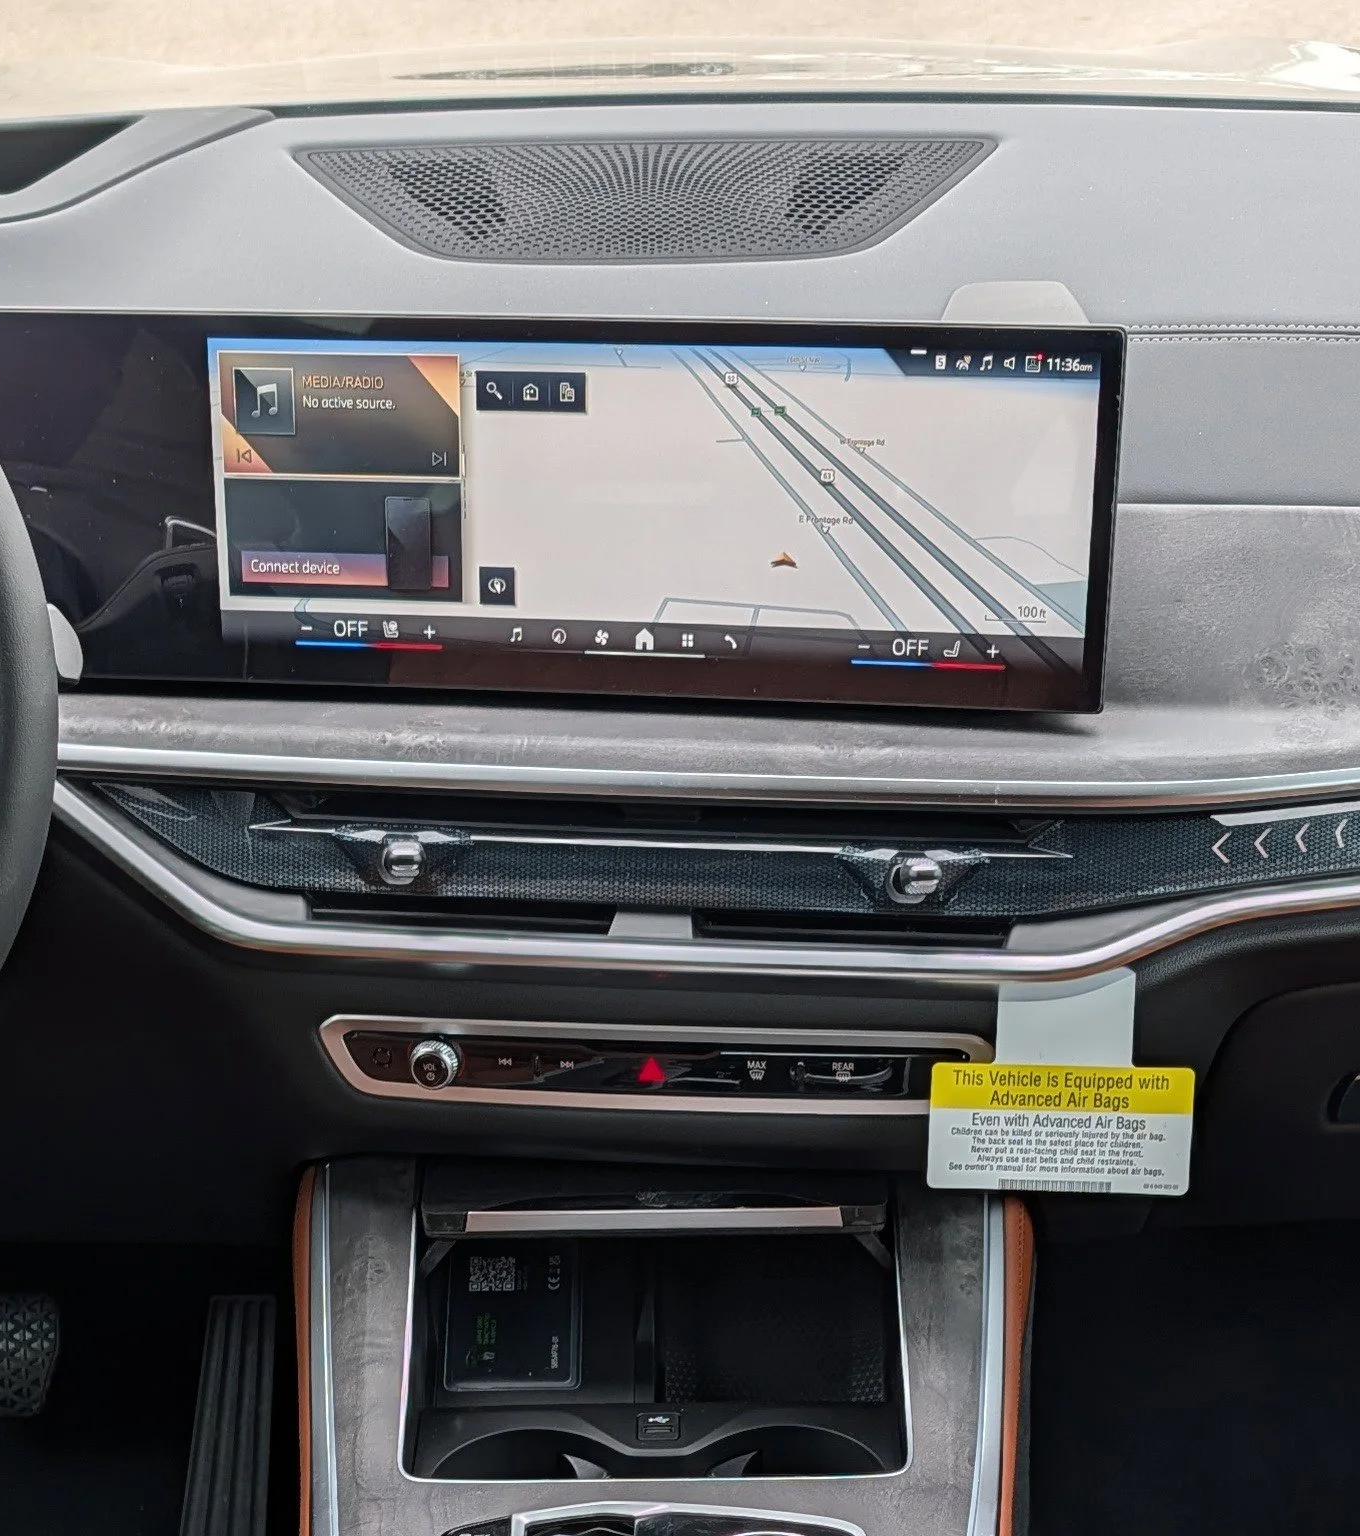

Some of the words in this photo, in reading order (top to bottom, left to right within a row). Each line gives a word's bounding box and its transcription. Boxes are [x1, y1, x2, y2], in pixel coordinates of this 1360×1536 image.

[302, 375, 384, 389] MEDIA/RADIO
[302, 395, 318, 408] No
[321, 396, 353, 409] active
[356, 399, 396, 410] source.
[806, 515, 841, 526] Frontage
[842, 516, 854, 525] Rd
[251, 559, 299, 573] Connect
[302, 561, 340, 575] device
[1017, 605, 1038, 618] 100
[1039, 607, 1047, 619] ft
[333, 620, 369, 638] OFF
[892, 638, 930, 656] OFF
[422, 1062, 437, 1071] VOL
[747, 1060, 767, 1069] MAX
[832, 1062, 855, 1071] REAR
[953, 1069, 984, 1086] This
[989, 1070, 1042, 1087] Vehicle
[1046, 1072, 1059, 1088] is
[1064, 1072, 1133, 1092] Equipped
[1138, 1074, 1169, 1090] with
[990, 1090, 1062, 1107] Advanced
[1067, 1092, 1088, 1107] Air
[1093, 1092, 1130, 1111] Bags
[972, 1112, 1000, 1126] Even
[1004, 1113, 1029, 1127] with
[1033, 1114, 1092, 1128] Advanced
[1095, 1115, 1114, 1129] Air
[1116, 1116, 1146, 1132] Bags
[951, 1127, 982, 1136] Children
[1001, 1128, 1010, 1136] be
[1012, 1128, 1032, 1137] killed
[1045, 1130, 1080, 1140] seriously
[1082, 1131, 1108, 1140] injured
[1111, 1132, 1120, 1142] by
[1122, 1132, 1135, 1140] the
[1149, 1133, 1167, 1142] bag.
[972, 1136, 985, 1144] The
[988, 1137, 1006, 1145] back
[1008, 1138, 1024, 1146] seat
[1026, 1138, 1033, 1146] is
[1035, 1138, 1047, 1146] the
[1049, 1138, 1072, 1147] safest
[1074, 1140, 1094, 1148] place
[1096, 1140, 1108, 1148] for
[1110, 1140, 1144, 1149] children.
[970, 1145, 992, 1153] Never
[994, 1146, 1007, 1155] put
[1016, 1147, 1057, 1156] rear-facing
[1059, 1148, 1078, 1156] child
[1108, 1149, 1120, 1157] the
[1122, 1150, 1144, 1158] front.
[977, 1154, 1003, 1164] Always
[1040, 1156, 1058, 1164] belts
[1060, 1156, 1074, 1164] and
[1076, 1157, 1095, 1165] child
[1097, 1158, 1137, 1166] restraints.
[948, 1162, 962, 1171] See
[964, 1163, 993, 1171] owner's
[996, 1164, 1024, 1172] manual
[1026, 1164, 1037, 1172] for
[1060, 1166, 1105, 1174] information
[1107, 1167, 1129, 1175] about
[1143, 1168, 1165, 1177] bags.
